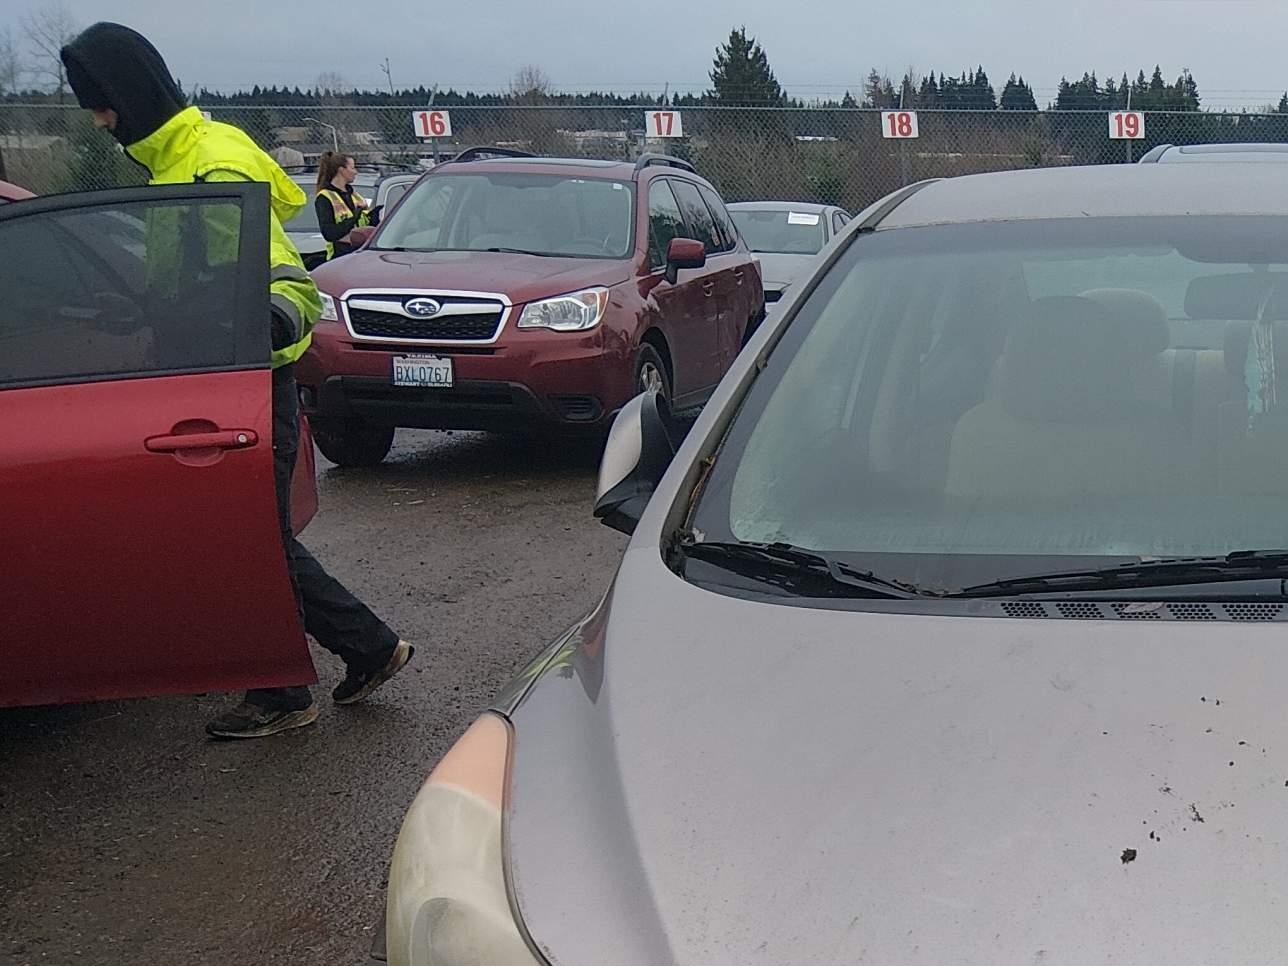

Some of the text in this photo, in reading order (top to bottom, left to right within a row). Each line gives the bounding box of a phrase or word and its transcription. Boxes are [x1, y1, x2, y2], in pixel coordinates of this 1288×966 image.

[419, 112, 446, 135] 16
[653, 112, 674, 135] 17
[887, 112, 912, 136] 18
[1114, 113, 1140, 137] 19
[396, 366, 450, 383] BXL0767
